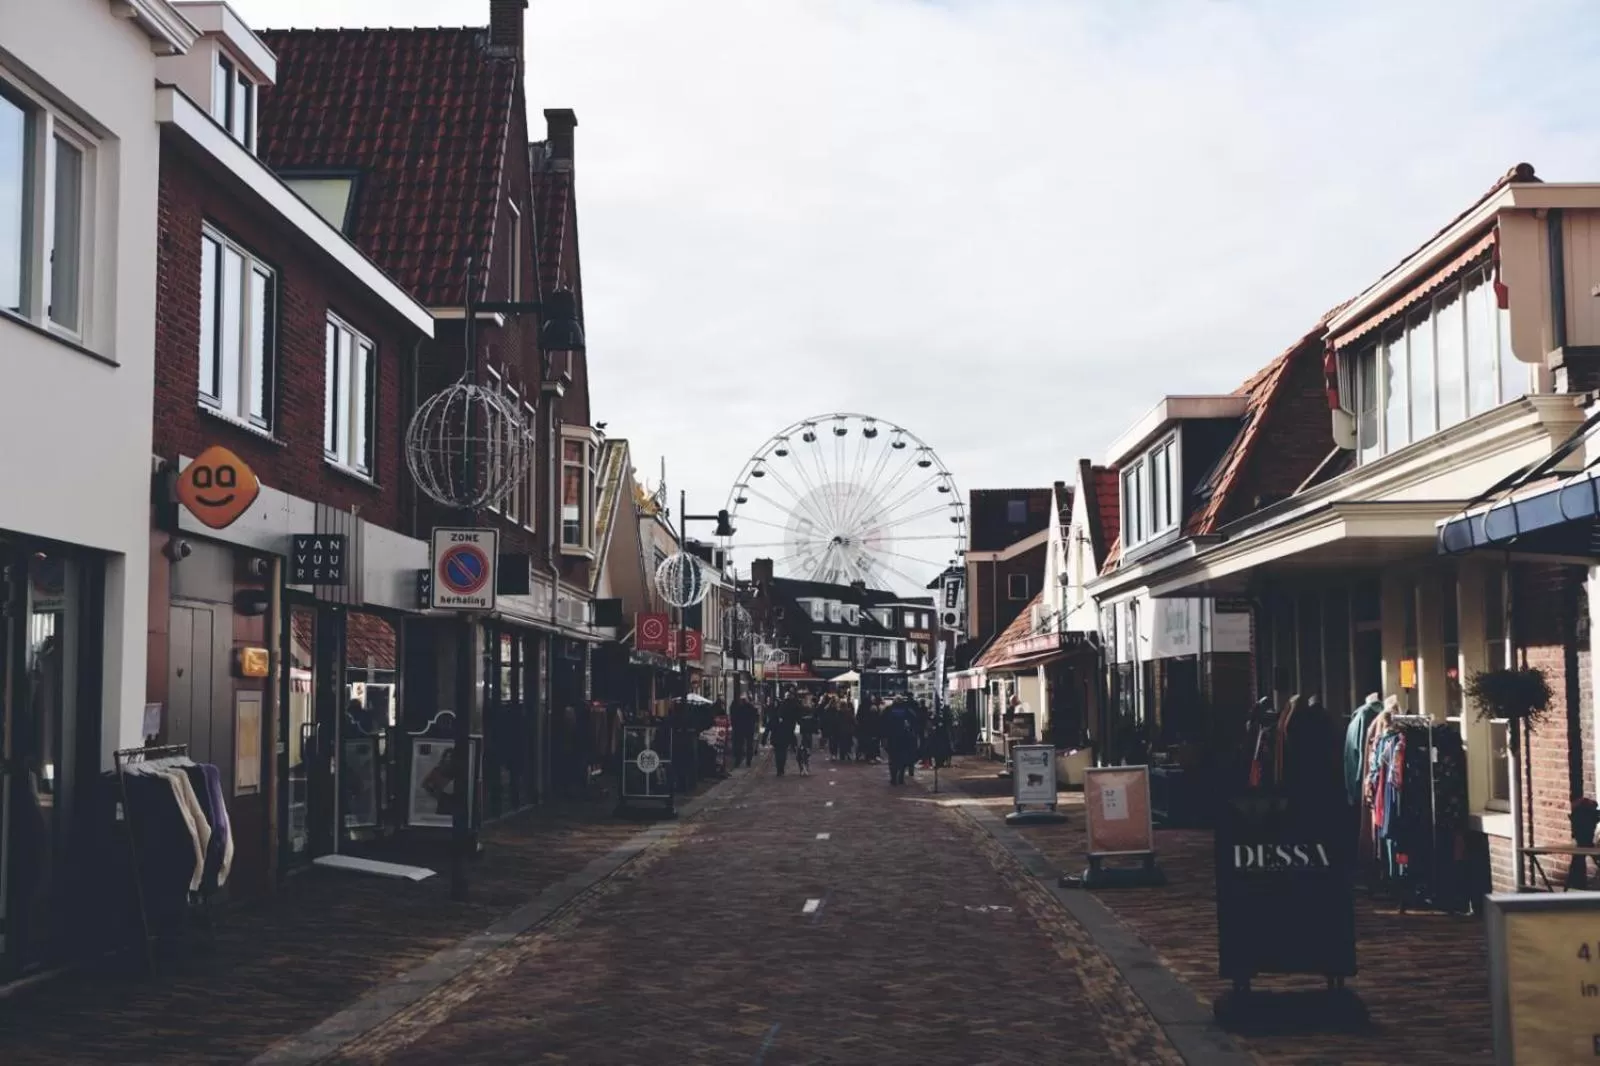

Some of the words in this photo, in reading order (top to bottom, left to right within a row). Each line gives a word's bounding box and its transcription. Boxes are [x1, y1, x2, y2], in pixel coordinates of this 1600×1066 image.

[450, 533, 480, 542] ZONE
[298, 539, 340, 550] VAN
[297, 554, 339, 565] VUU
[297, 568, 339, 579] REN
[440, 595, 486, 606] herhaling
[1233, 843, 1330, 867] DESSA
[1576, 942, 1592, 963] 4
